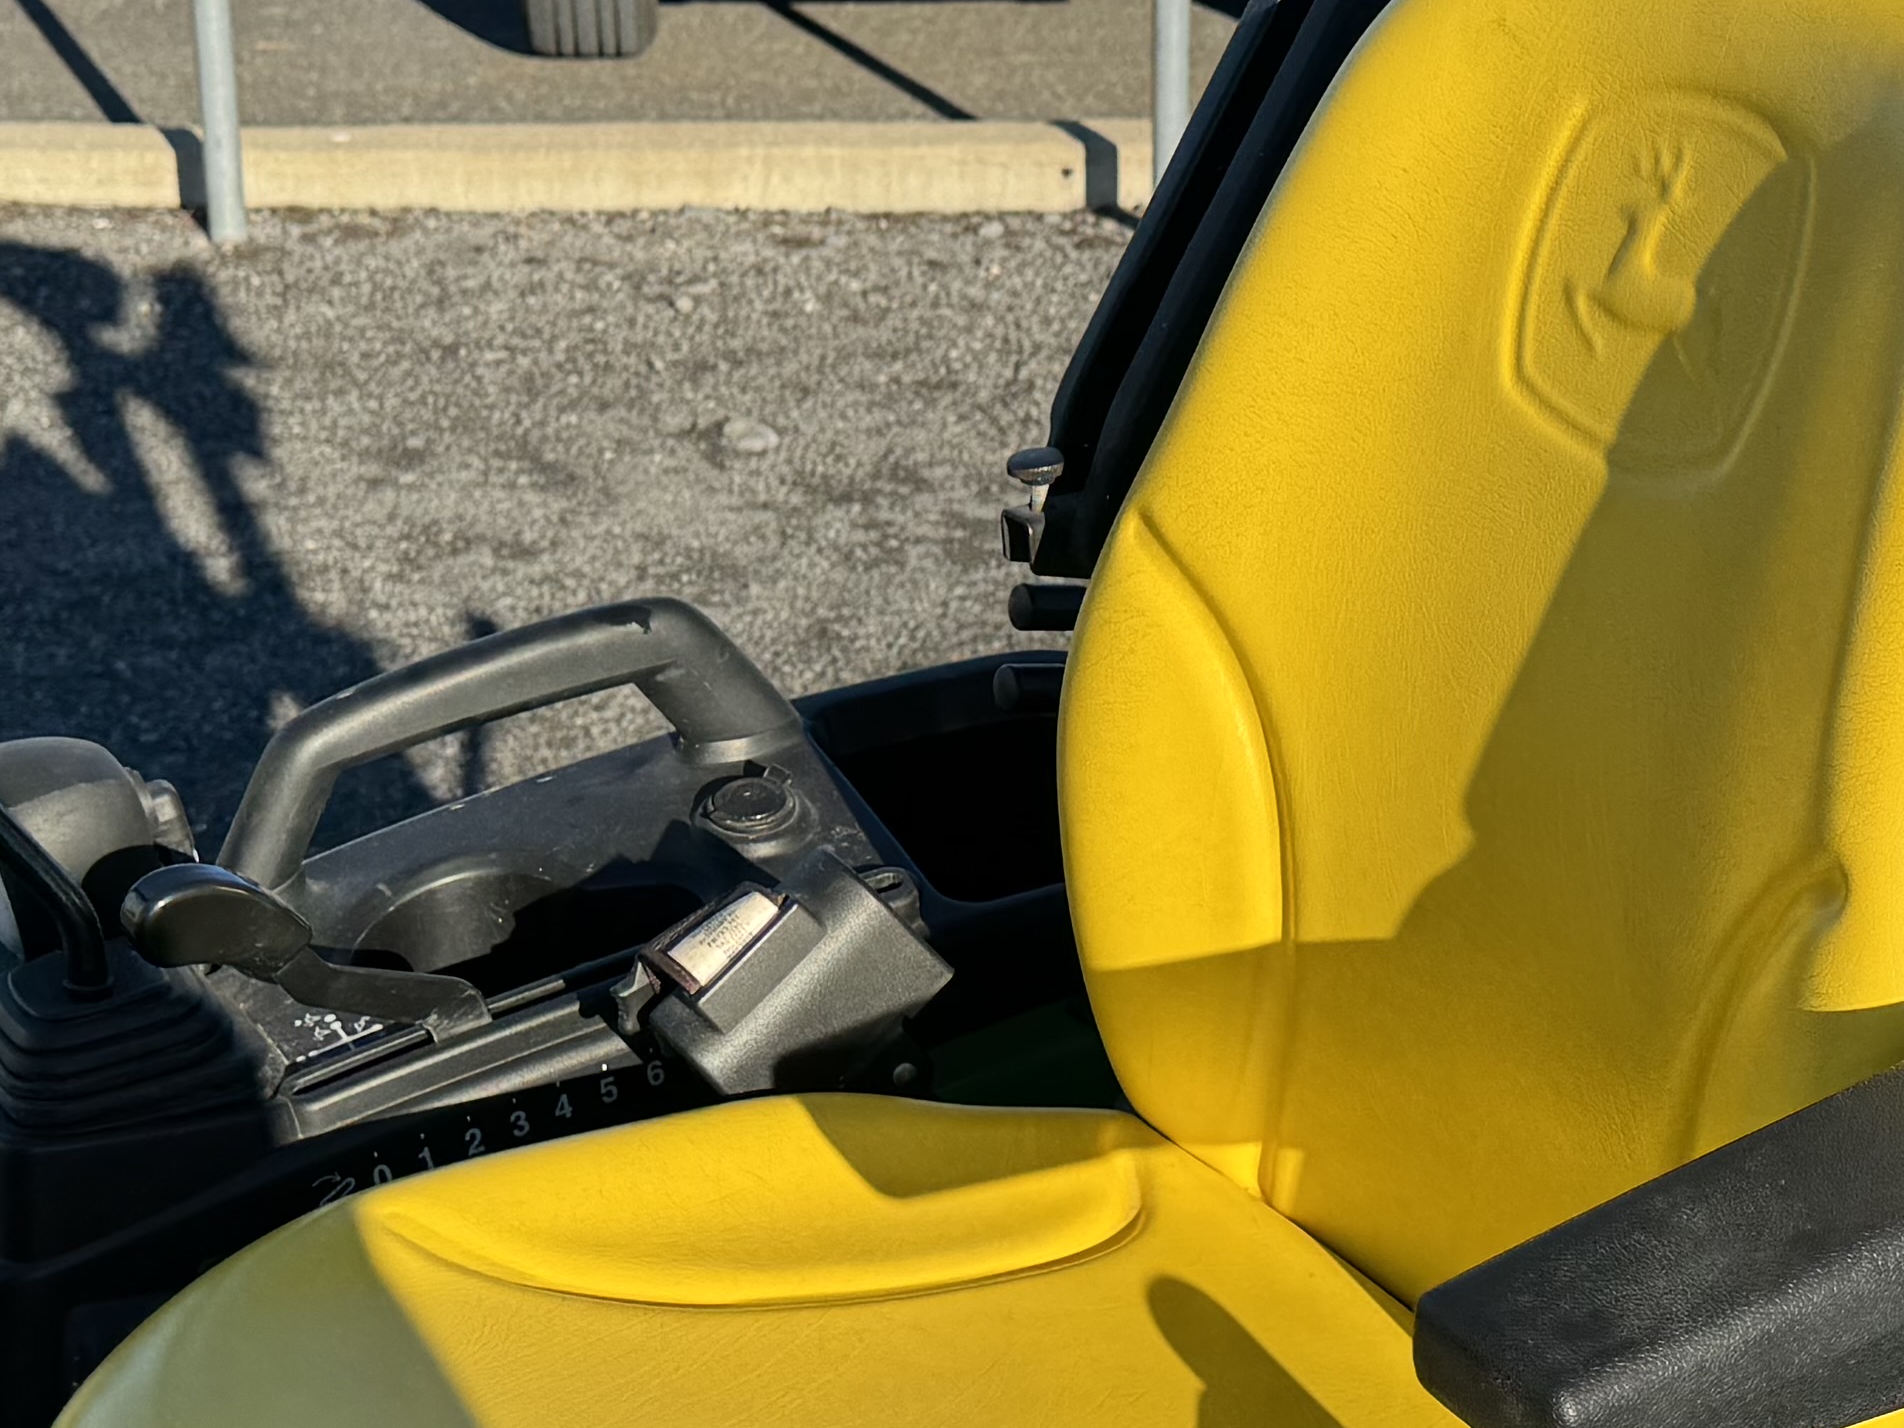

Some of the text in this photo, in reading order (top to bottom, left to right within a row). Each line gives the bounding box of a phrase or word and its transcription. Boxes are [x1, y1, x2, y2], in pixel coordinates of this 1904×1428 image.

[373, 1060, 665, 1186] 0 1 2 3 4 5 6
